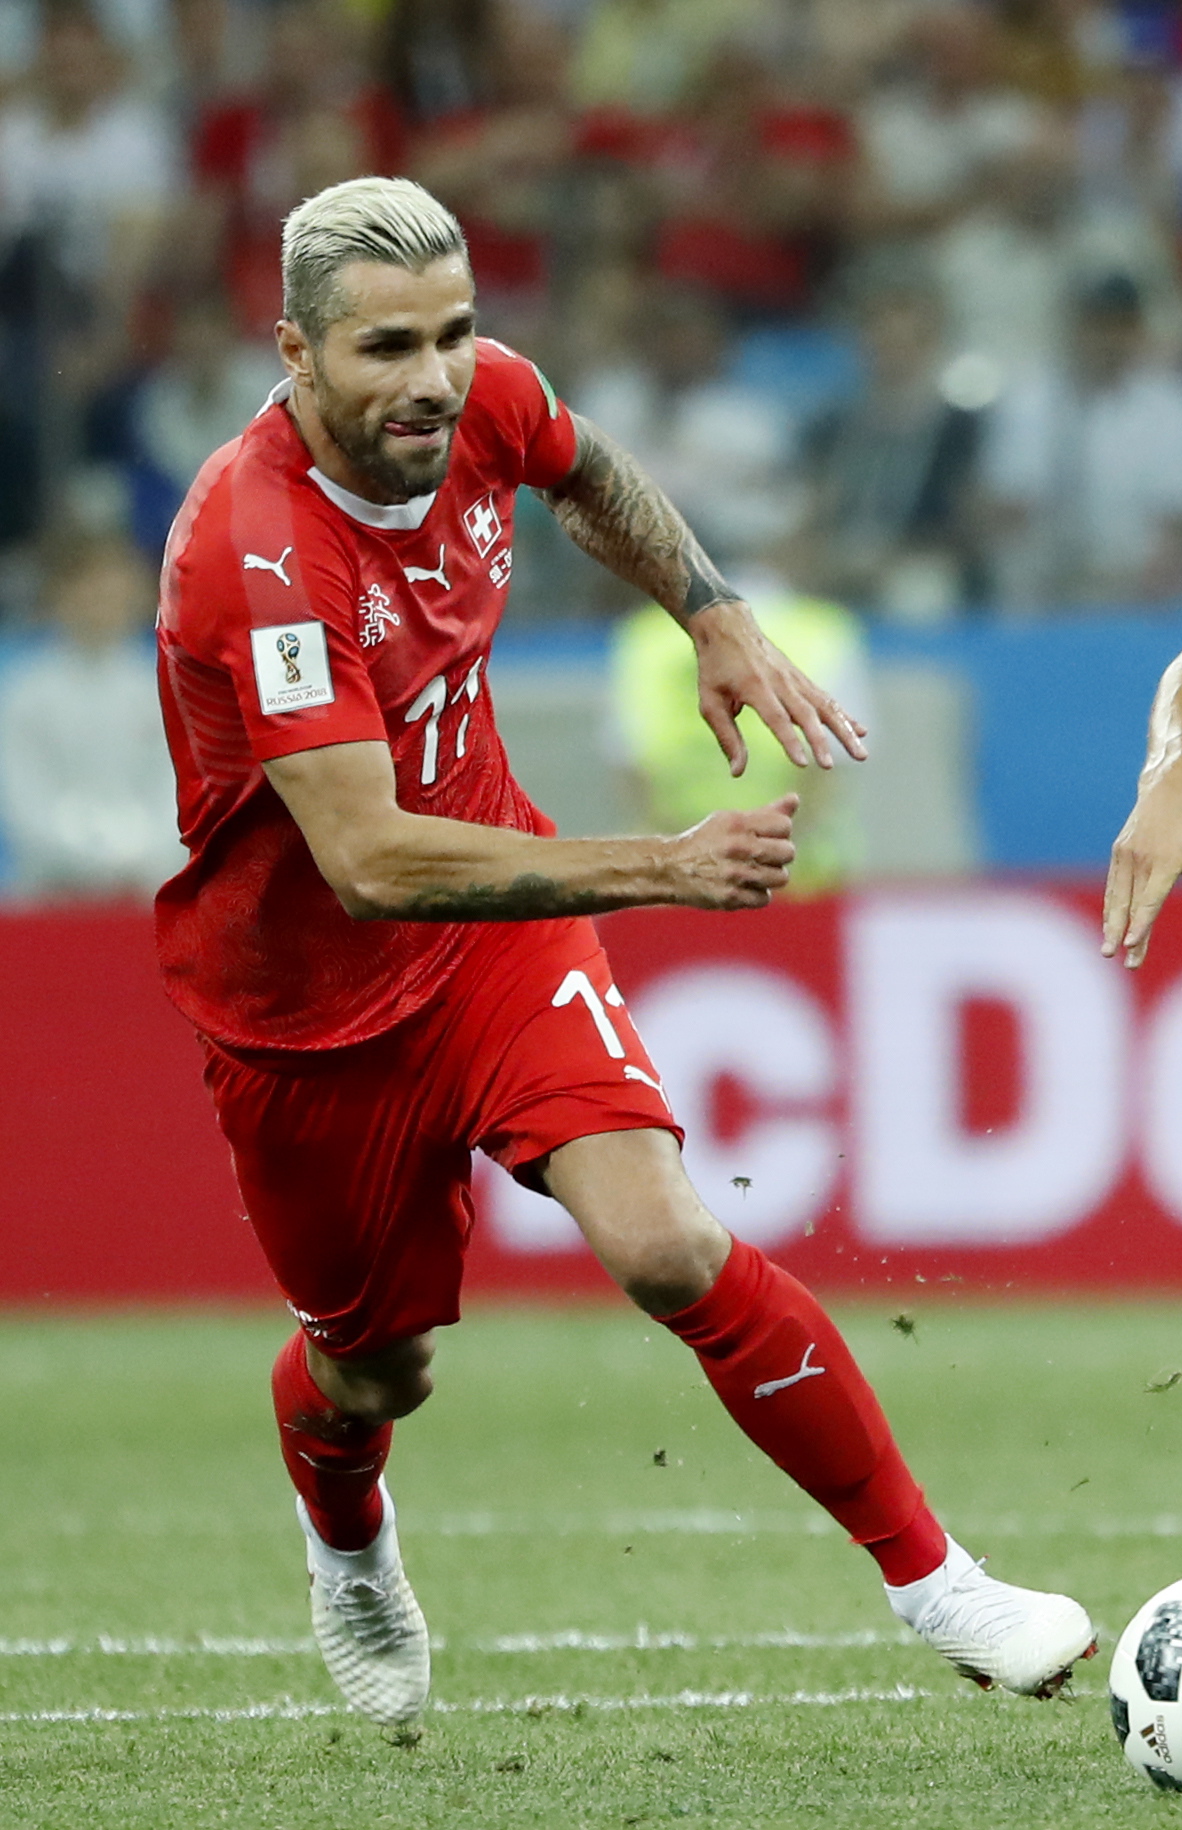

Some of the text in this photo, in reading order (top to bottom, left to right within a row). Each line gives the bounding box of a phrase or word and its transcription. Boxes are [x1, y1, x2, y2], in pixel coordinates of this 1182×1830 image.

[266, 692, 303, 707] RUSSIA
[304, 687, 328, 700] 2018
[403, 655, 484, 786] 11
[551, 969, 627, 1059] 1
[1155, 1714, 1173, 1764] adidas
